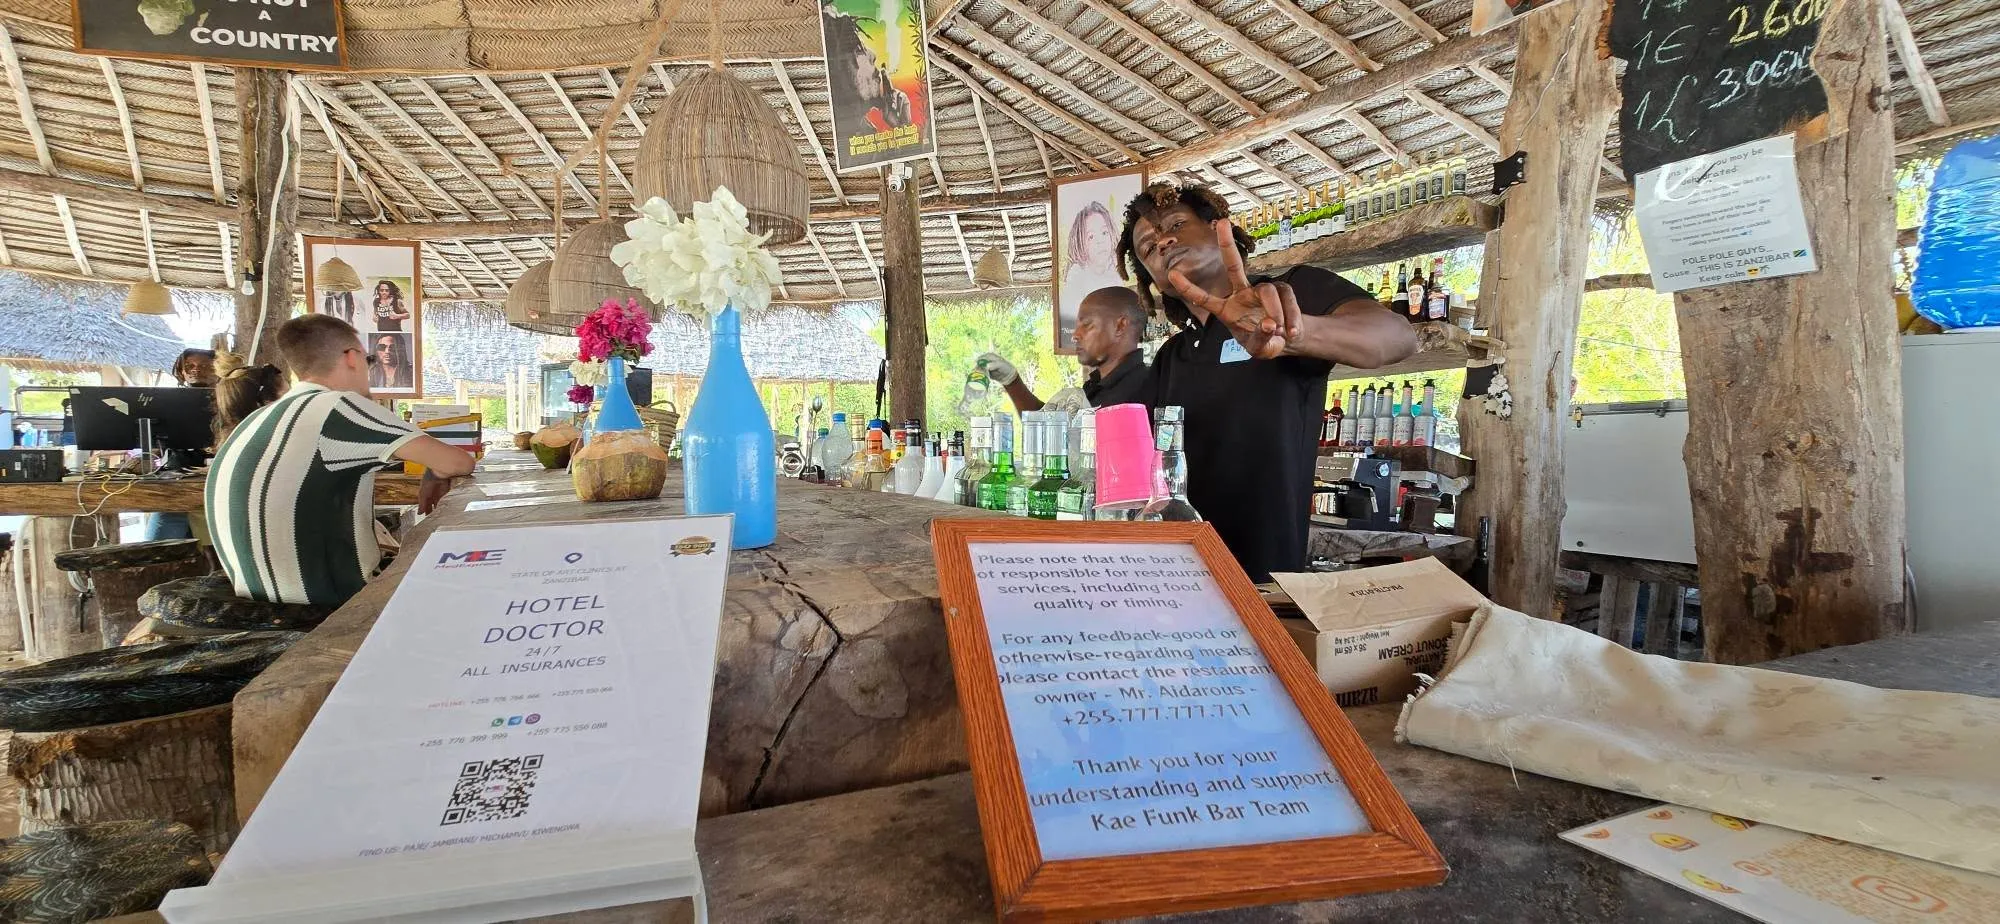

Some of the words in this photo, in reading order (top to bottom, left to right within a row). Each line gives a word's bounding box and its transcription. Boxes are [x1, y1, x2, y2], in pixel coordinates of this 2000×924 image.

[258, 10, 272, 21] A
[190, 26, 338, 52] COUNTRY
[1730, 151, 1749, 162] may
[1662, 269, 1690, 279] Cause
[1724, 260, 1734, 269] IS
[1736, 252, 1790, 267] ZANZIBAR
[1682, 255, 1706, 265] POLE
[1709, 250, 1736, 261] POLE
[1699, 273, 1721, 283] Keep
[1724, 270, 1745, 279] calm
[978, 555, 1035, 564] Please
[1040, 555, 1077, 564] note
[1083, 554, 1115, 564] that
[1120, 555, 1146, 564] the
[1149, 555, 1176, 564] bar
[1180, 555, 1195, 564] is
[977, 569, 995, 579] ot
[1001, 568, 1100, 580] responsible
[1105, 568, 1128, 578] for
[1134, 569, 1211, 578] restauran
[998, 583, 1077, 595] services,
[1081, 582, 1160, 593] including
[1163, 582, 1202, 592] food
[505, 594, 605, 615] HOTEL
[1033, 598, 1093, 611] quality
[1100, 599, 1118, 608] or
[1123, 597, 1183, 609] timing.
[483, 619, 604, 644] DOCTOR
[1002, 633, 1033, 645] For
[1041, 634, 1073, 645] any
[1079, 629, 1216, 643] feedback-good
[1220, 629, 1238, 639] or
[525, 645, 563, 657] 24/7
[999, 647, 1194, 664] otherwise-regarding
[1378, 643, 1413, 660] CREAM
[460, 665, 490, 677] ALL
[500, 655, 607, 674] INSURANCES
[1066, 667, 1139, 681] contact
[1145, 665, 1176, 678] the
[1181, 664, 1276, 677] restaurant
[1034, 691, 1097, 704] owner
[1119, 687, 1152, 700] Mr.
[1159, 683, 1246, 699] Aidarous
[1062, 703, 1251, 726] +255.777.777.711
[1073, 755, 1143, 775] Thank
[1150, 755, 1190, 773] you
[1194, 751, 1224, 767] for
[1232, 750, 1278, 767] your
[1030, 779, 1199, 807] understanding
[1207, 774, 1246, 793] and
[1251, 770, 1339, 791] support.
[1091, 813, 1137, 832] Kae
[1143, 805, 1202, 827] Funk
[1206, 803, 1245, 821] Bar
[1249, 800, 1310, 817] Team
[358, 847, 383, 857] FIND
